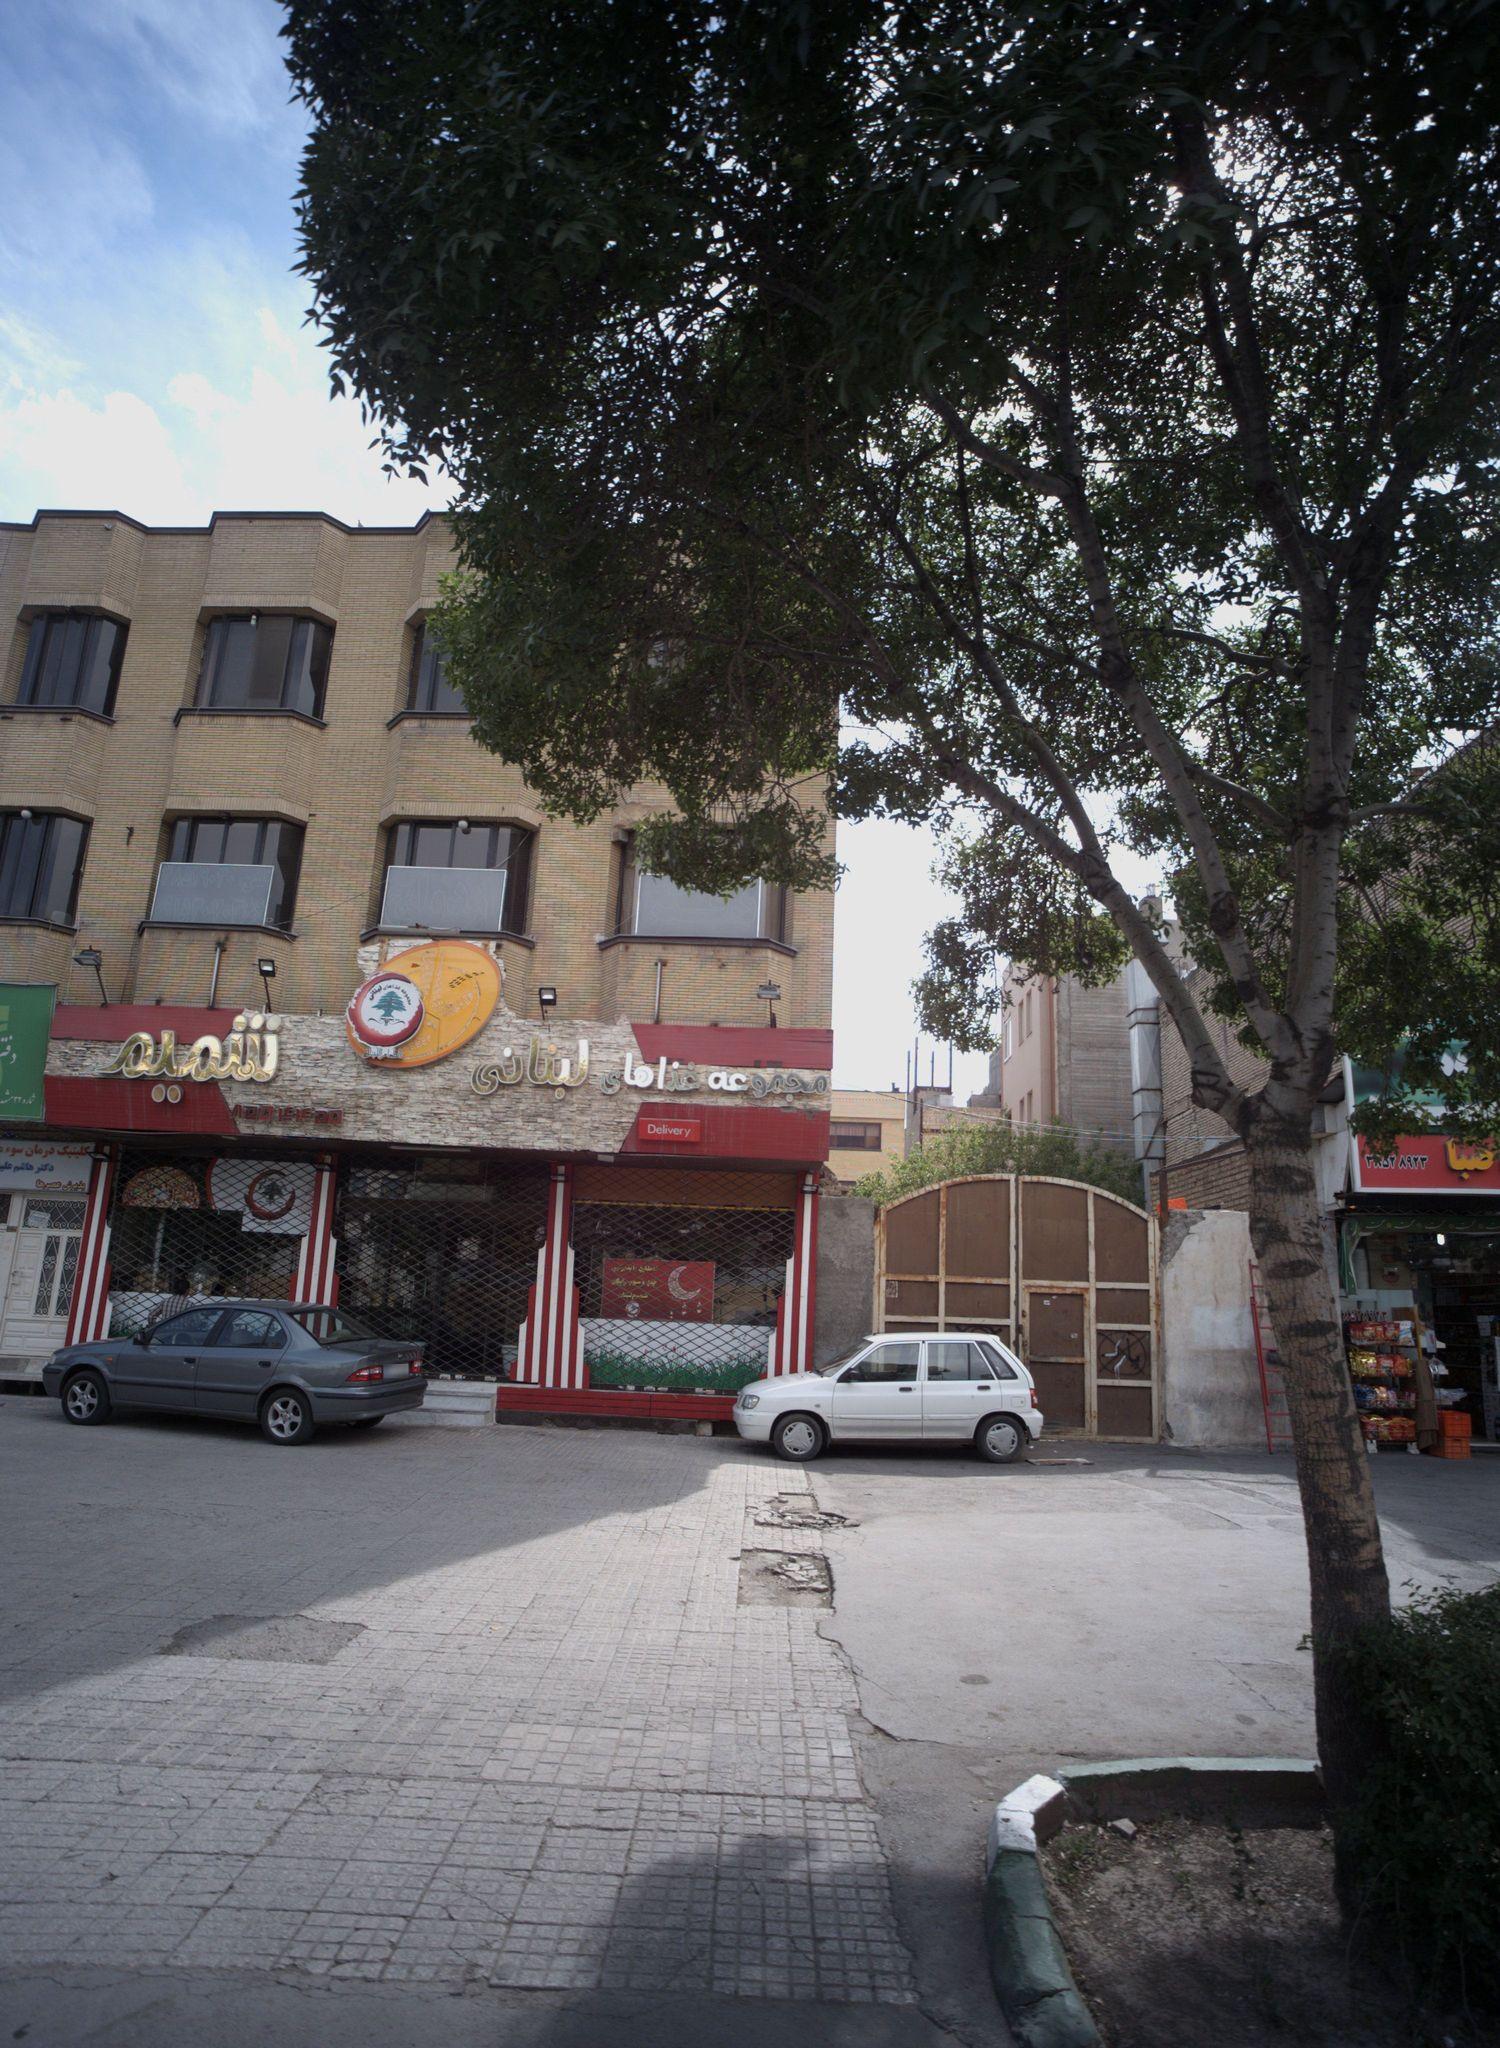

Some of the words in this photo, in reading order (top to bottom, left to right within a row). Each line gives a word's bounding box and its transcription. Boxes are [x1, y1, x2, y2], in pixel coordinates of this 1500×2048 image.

[97, 1013, 283, 1104] شمیم
[470, 1035, 590, 1100] لبنانی
[600, 1051, 700, 1096] غذاهای
[707, 1070, 830, 1103] مجموعه
[647, 1123, 691, 1138] Delivery
